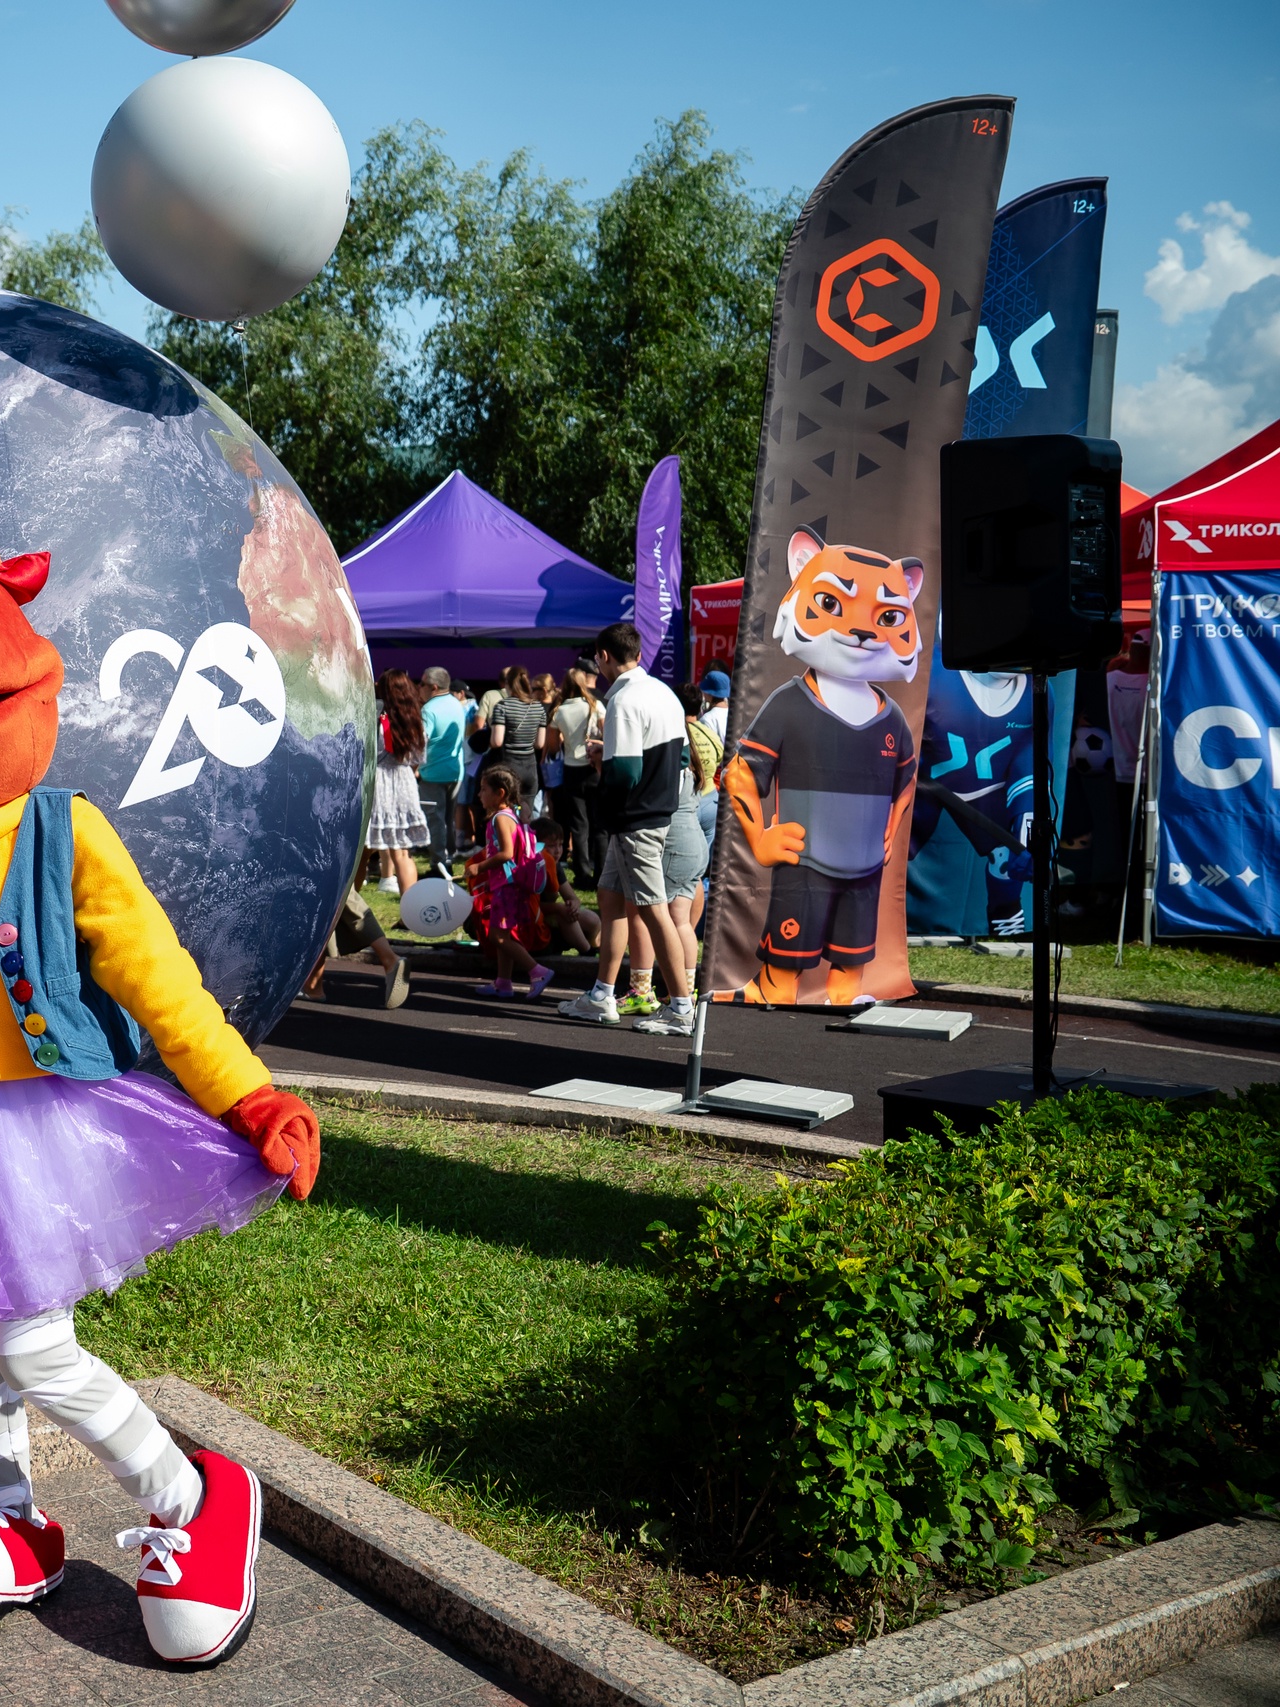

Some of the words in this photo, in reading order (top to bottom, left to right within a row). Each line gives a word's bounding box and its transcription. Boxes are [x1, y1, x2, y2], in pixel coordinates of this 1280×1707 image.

[972, 118, 998, 135] 12+
[1073, 200, 1095, 213] 12+
[1095, 324, 1111, 334] 12+
[1198, 522, 1280, 538] ТРИКОЛ
